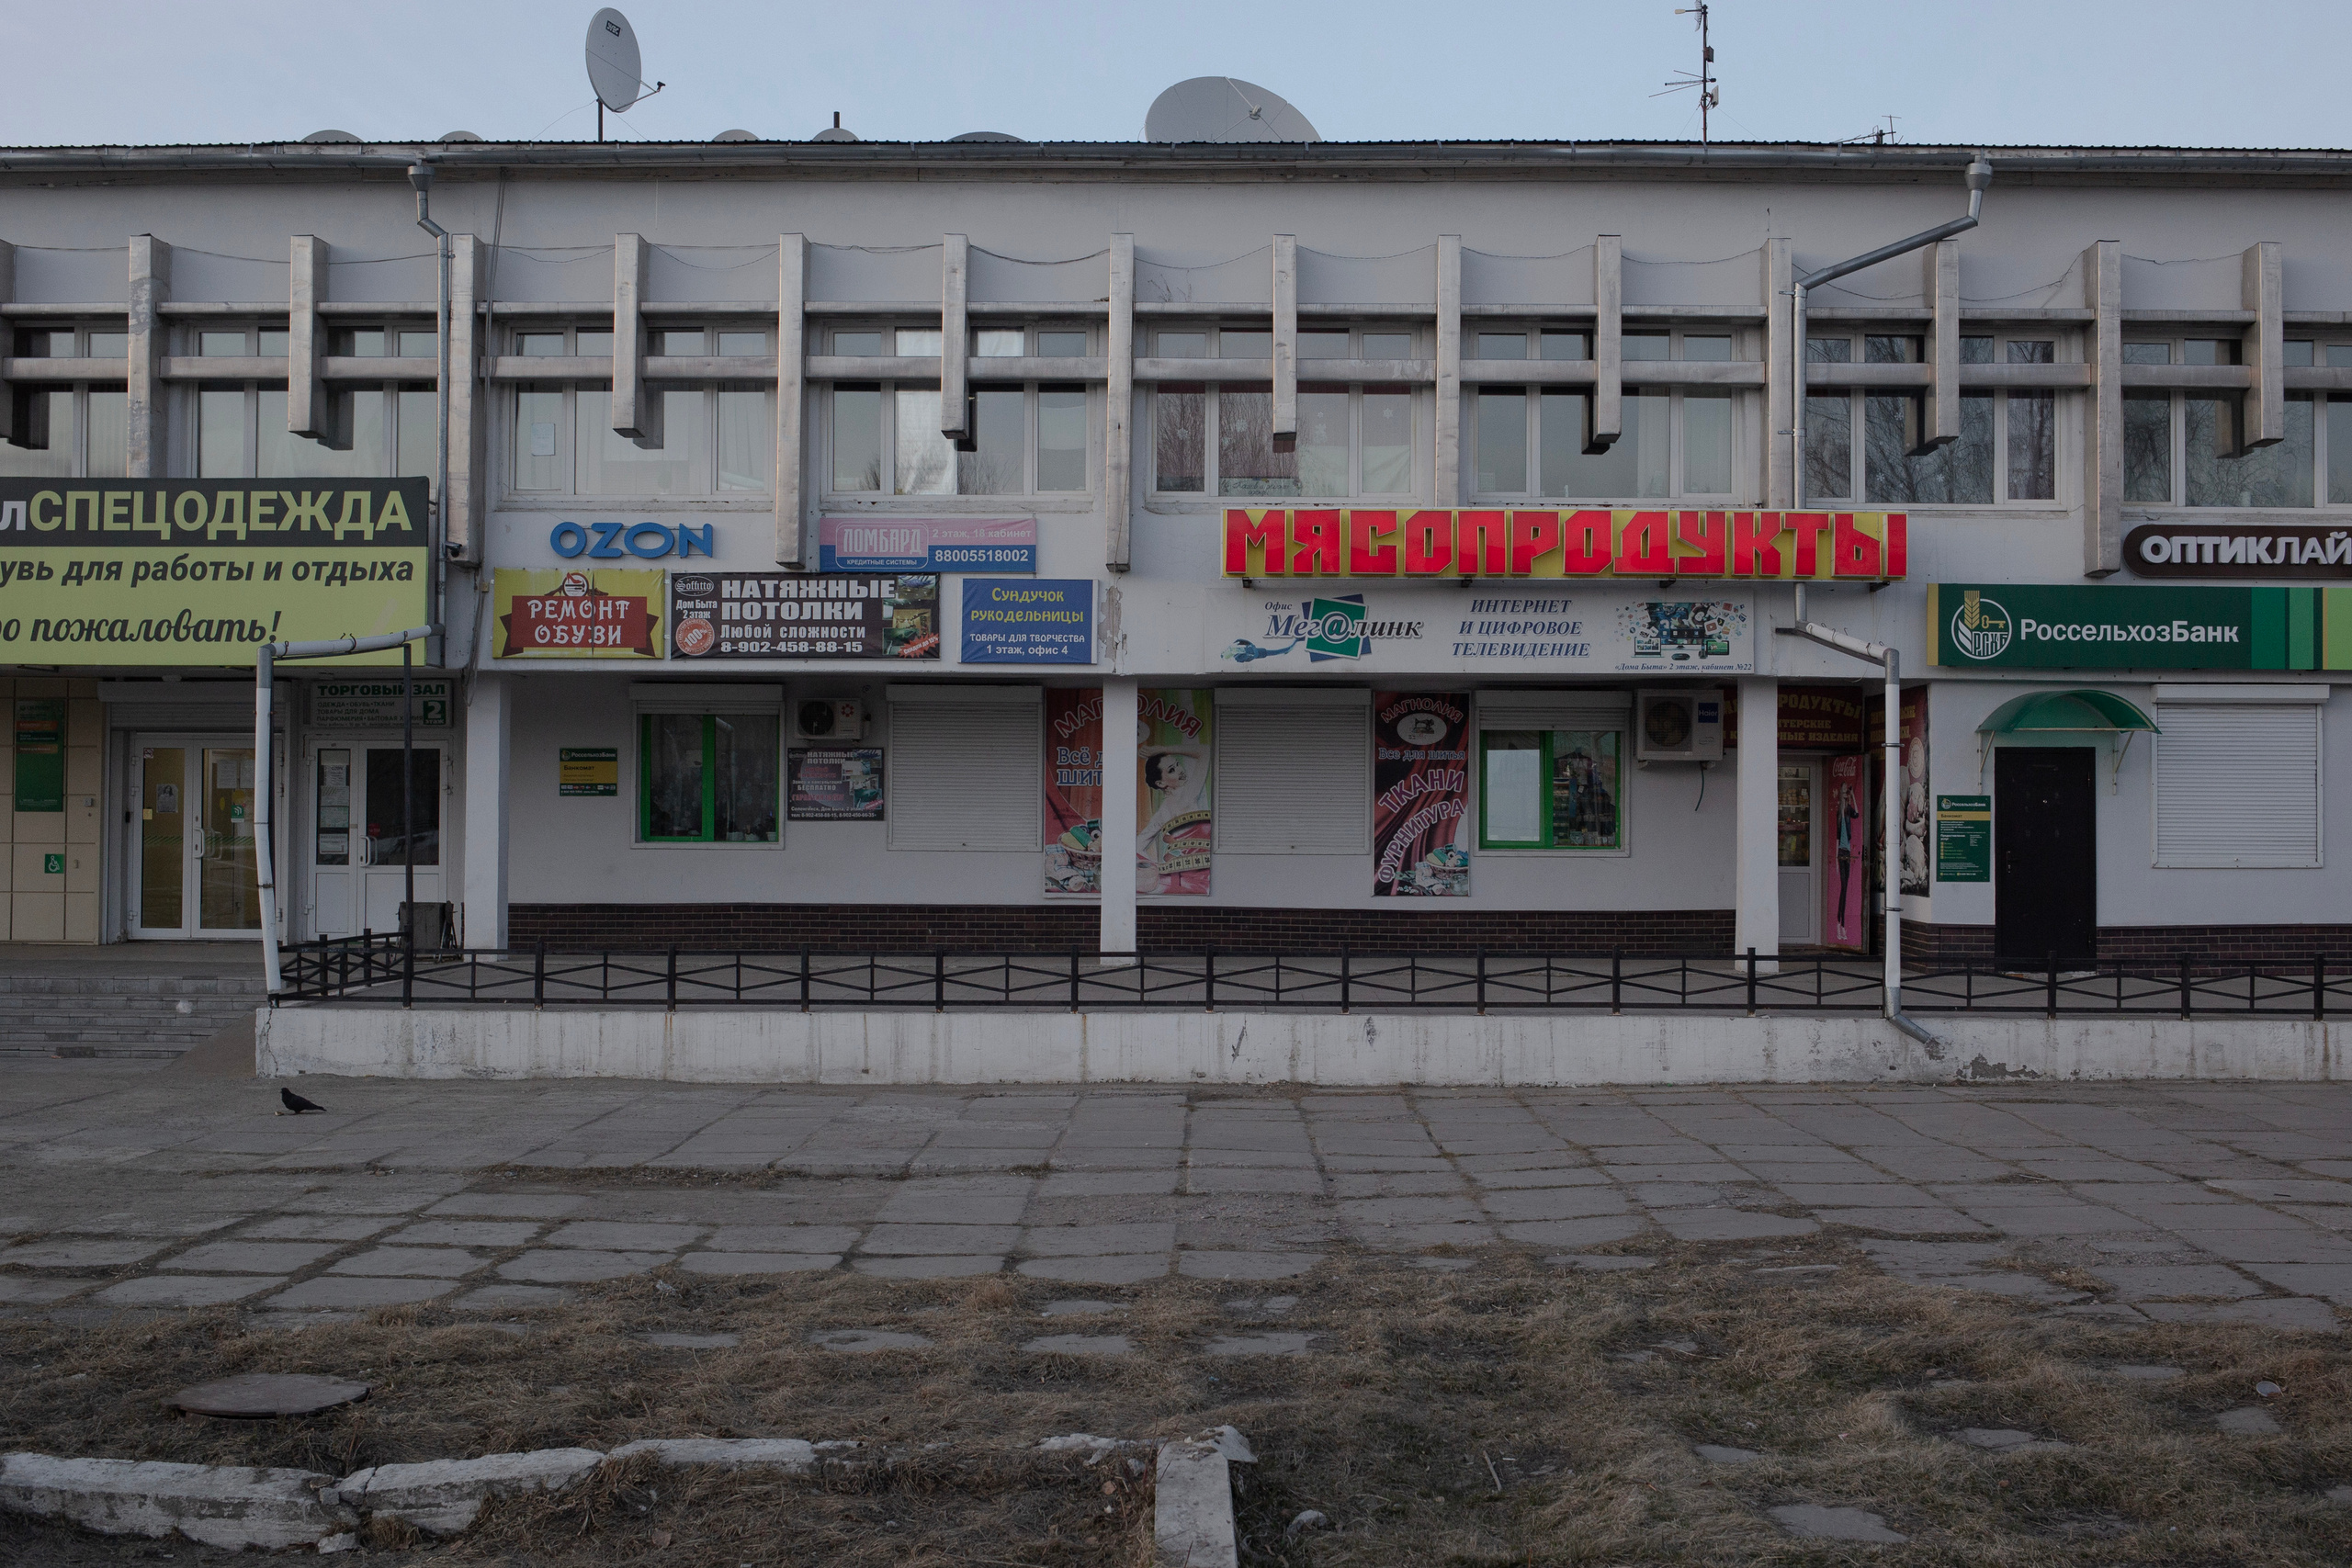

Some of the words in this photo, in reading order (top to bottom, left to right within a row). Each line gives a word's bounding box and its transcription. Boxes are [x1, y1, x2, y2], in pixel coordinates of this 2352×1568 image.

[549, 522, 713, 558] OZON
[843, 528, 922, 555] ЛОМБАРД
[933, 529, 938, 538] 2
[942, 530, 970, 538] этаж,
[988, 529, 1032, 538] кабинет
[1225, 508, 1907, 578] МЯСОПРОДУКТЫ
[2140, 531, 2352, 565] ОПТИКЛАЙ
[934, 549, 1028, 562] 88005518002
[62, 560, 123, 587] для
[130, 554, 254, 588] работы
[264, 560, 283, 581] и
[292, 560, 413, 586] отдыха
[676, 580, 712, 591] Soffitto
[721, 580, 895, 599] НАТЯЖНЫЕ
[676, 600, 695, 610] Дом
[695, 599, 718, 609] Быта
[992, 587, 1065, 604] Сундучок
[526, 599, 630, 623] РЕМОНТ
[683, 610, 688, 619] 2
[689, 611, 711, 619] этаж
[721, 601, 863, 620] ПОТОЛКИ
[1264, 602, 1292, 611] Офис
[1470, 599, 1572, 614] ИНТЕРНЕТ
[30, 608, 282, 643] пожаловать!
[720, 623, 772, 639] Любой
[779, 625, 865, 639] сложности
[1458, 621, 1474, 635] И
[1477, 621, 1583, 637] ЦИФРОВОЕ
[2020, 618, 2240, 643] РоссельхозБанк
[534, 625, 622, 647] ОБУВИ
[684, 627, 707, 647] 100%
[970, 633, 1006, 642] ТОВАРЫ
[1008, 634, 1027, 643] ДЛЯ
[1029, 634, 1085, 643] ТВОРЧЕСТВА
[720, 641, 863, 653] 8-902-458-88-15
[987, 645, 992, 654] 1
[996, 647, 1025, 656] этаж,
[1028, 645, 1058, 657] офис
[1061, 645, 1069, 654] 4
[1453, 642, 1591, 658] ТЕЛЕВИДЕНИЕ
[318, 682, 405, 695] ТОРГОВЫЙ
[413, 684, 446, 695] ЗАЛ
[426, 700, 442, 719] 2
[1054, 694, 1204, 739] МАГОЛИЯ
[1381, 697, 1464, 724] МАГНОЛИЯ
[1809, 732, 1859, 743] ИЗДЕЛИЯ
[1056, 746, 1091, 765] Всё
[1402, 748, 1425, 761] для
[1428, 748, 1465, 760] шитья
[1057, 768, 1102, 786] шит
[1377, 768, 1464, 814] ТКАНИ
[1377, 798, 1464, 883] ФУРНИТУРА
